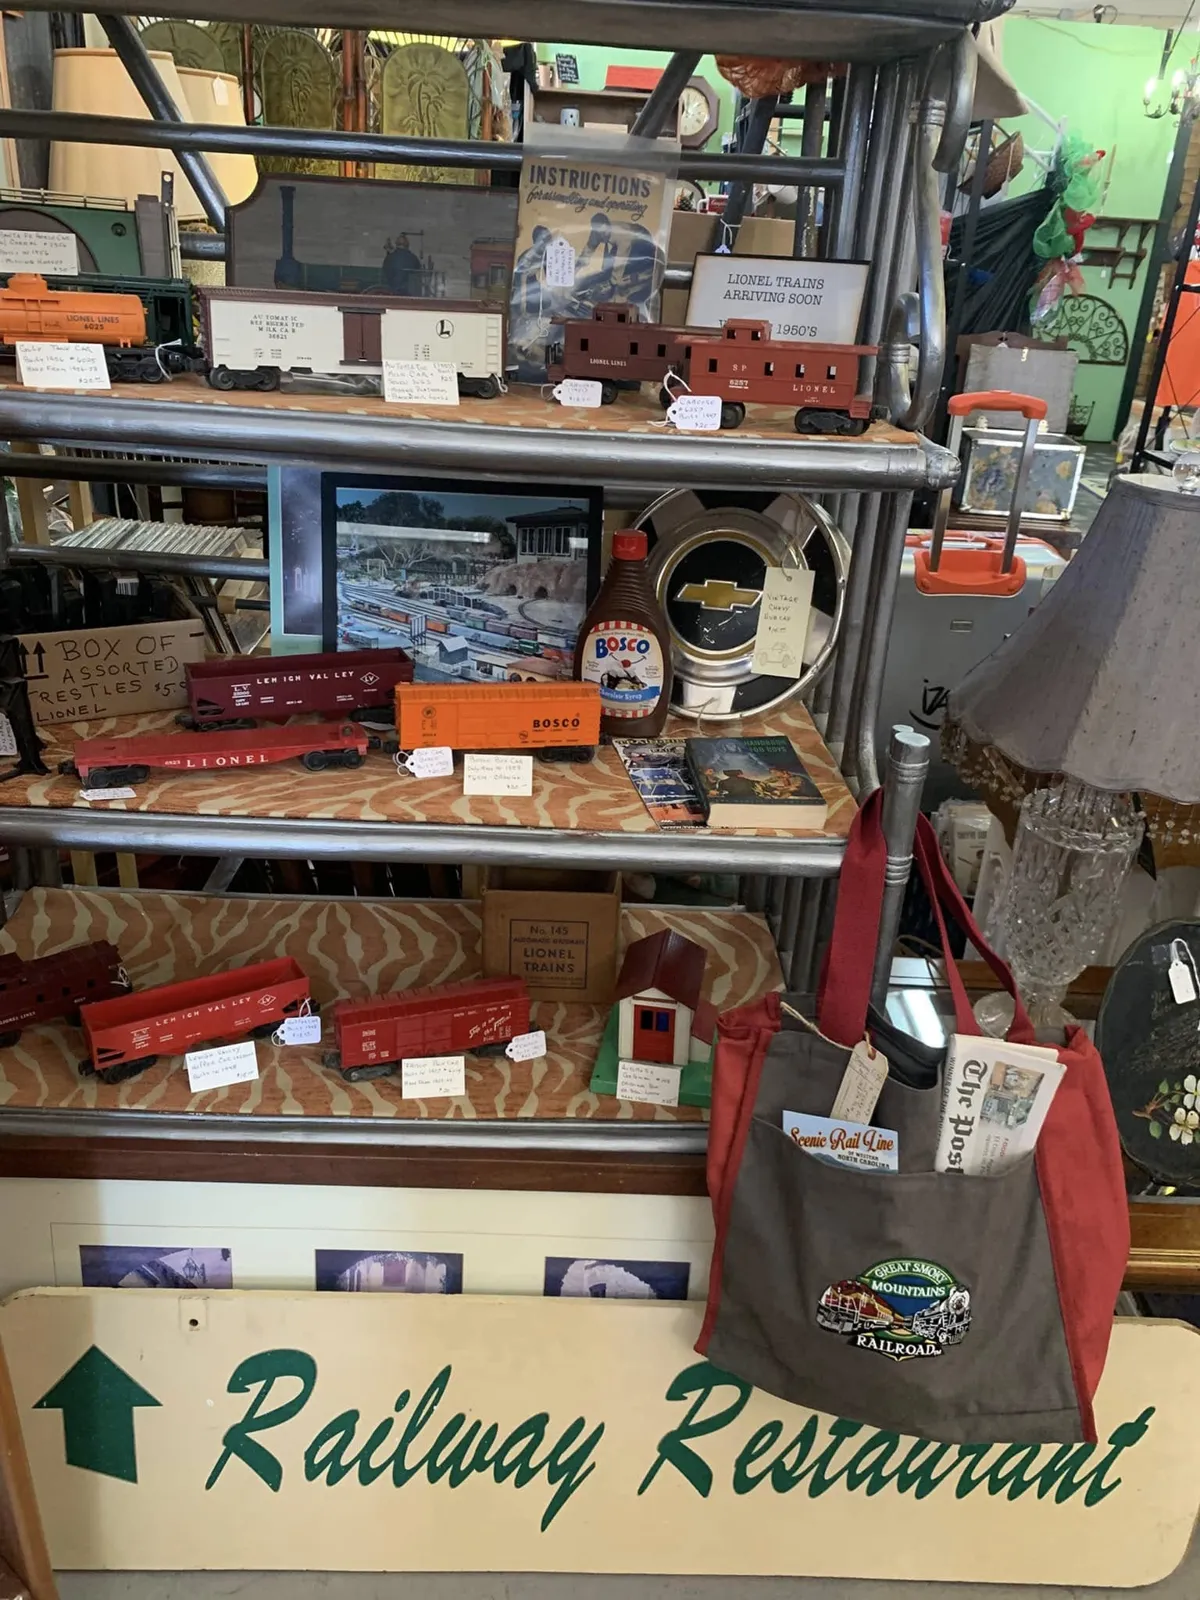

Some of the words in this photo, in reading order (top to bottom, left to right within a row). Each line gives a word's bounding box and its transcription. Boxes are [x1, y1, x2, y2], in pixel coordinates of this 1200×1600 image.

[529, 164, 651, 198] INSTRUCTIONS
[526, 185, 543, 204] for
[605, 199, 648, 222] operating
[727, 273, 773, 287] LIONEL
[776, 276, 825, 290] TRAINS
[723, 289, 786, 304] ARRIVING
[788, 293, 823, 306] SOON
[66, 314, 95, 323] LIONEL
[97, 316, 120, 324] LINES
[775, 323, 818, 338] 1950'S
[589, 357, 610, 366] LIONEL
[610, 359, 627, 367] LINES
[729, 378, 749, 387] 6257
[792, 384, 836, 394] LIONEL
[766, 593, 799, 603] VINTAGE
[768, 603, 791, 613] CHEVY
[55, 638, 121, 662] BOX
[135, 634, 176, 655] OF
[595, 636, 650, 659] BOSCO
[62, 655, 179, 684] ASSORTED
[256, 674, 302, 685] LEHIGH
[309, 670, 355, 681] VALLEY
[37, 703, 107, 722] LIONEL
[532, 718, 580, 729] BOSCO
[186, 754, 269, 769] LIONEL
[550, 926, 569, 935] 145
[523, 947, 575, 960] LIONEL
[523, 961, 575, 974] TRAINS
[155, 1010, 200, 1027] LEHIGH
[208, 996, 251, 1013] VALLEY
[956, 1059, 989, 1109] The
[790, 1126, 827, 1149] Scenic
[829, 1127, 860, 1150] Rail
[863, 1129, 894, 1152] Line
[944, 1113, 976, 1174] Post
[837, 1154, 858, 1163] NORTH
[859, 1158, 890, 1169] CAROLINA
[875, 1262, 912, 1278] GREAT
[912, 1263, 948, 1283] SMOKY
[871, 1280, 946, 1297] MOUNTAINS
[857, 1334, 935, 1356] RAILROAD
[205, 1348, 606, 1533] Railway
[637, 1360, 1157, 1507] Restaurant
